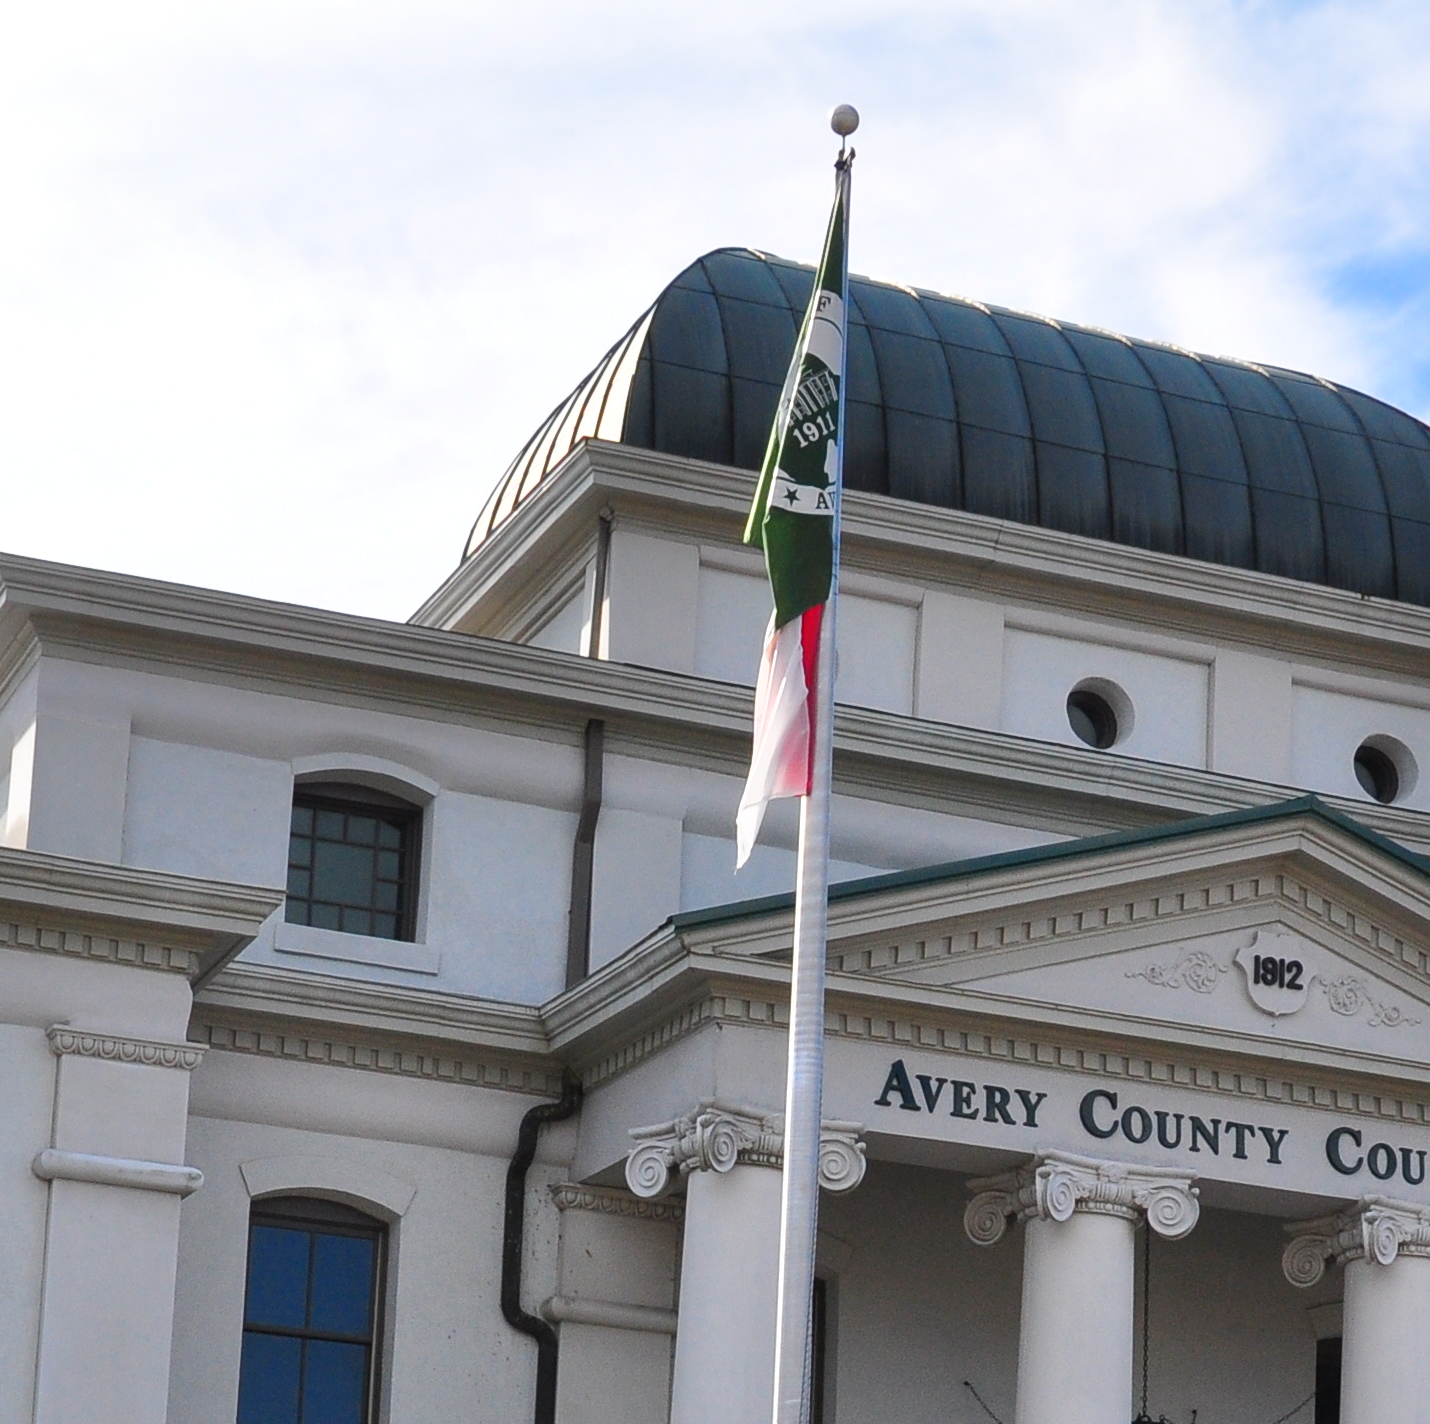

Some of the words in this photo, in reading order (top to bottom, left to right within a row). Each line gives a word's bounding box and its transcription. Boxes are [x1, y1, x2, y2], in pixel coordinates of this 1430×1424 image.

[793, 411, 836, 448] 1911
[1253, 954, 1304, 991] 1912
[874, 1059, 1048, 1128] AVERY
[1078, 1089, 1289, 1165] COUNTY
